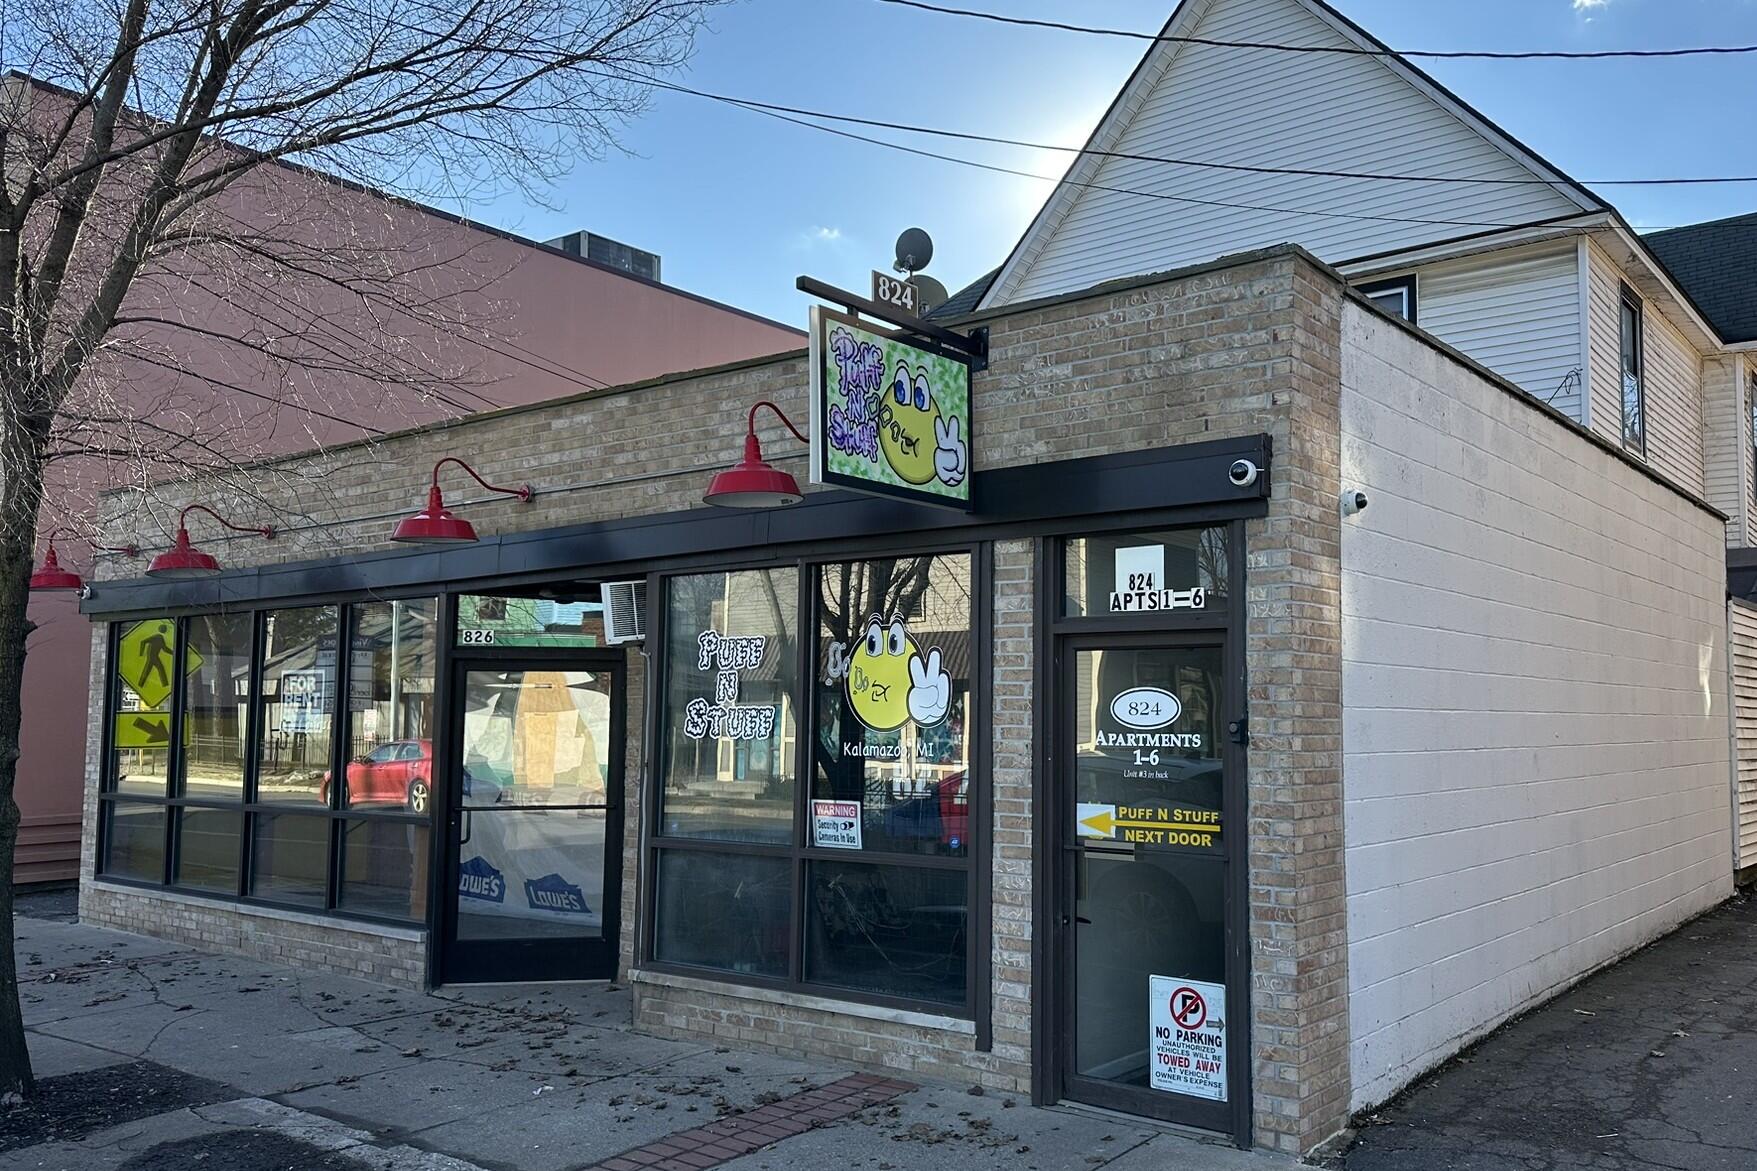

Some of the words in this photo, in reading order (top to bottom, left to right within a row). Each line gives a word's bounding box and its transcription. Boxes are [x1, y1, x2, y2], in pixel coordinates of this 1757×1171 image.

[878, 276, 913, 310] 824
[847, 386, 866, 424] N
[1128, 573, 1153, 591] 824
[463, 630, 493, 644] 826
[698, 630, 766, 670] PUFF
[288, 675, 316, 691] FOR
[716, 670, 739, 703] N
[284, 692, 321, 707] RENT
[1128, 701, 1162, 716] 824
[684, 698, 776, 740] STUFF
[1096, 730, 1201, 747] APARTMENTS
[916, 742, 935, 757] MI
[1133, 750, 1160, 765] 1-6
[1123, 769, 1137, 778] Unit
[1139, 770, 1147, 778] #3
[1148, 770, 1154, 778] in
[1155, 770, 1169, 779] back
[815, 804, 856, 818] WARNING
[1118, 806, 1153, 820] PUFF
[1156, 808, 1169, 821] N
[1174, 808, 1219, 823] STUFF
[817, 819, 839, 833] Security
[817, 831, 840, 843] Cameras
[846, 834, 856, 844] Use
[1124, 830, 1164, 844] NEXT
[1168, 831, 1212, 846] DOOR
[459, 875, 500, 897] OWE'S
[529, 885, 582, 910] LOWE'S
[1156, 1026, 1170, 1039] NO
[1176, 1029, 1222, 1048] PARKING
[1156, 1046, 1190, 1056] VEHICLES
[1192, 1051, 1210, 1060] WILL
[1212, 1054, 1222, 1062] BE
[1162, 1040, 1216, 1054] UNAUTHORIZED
[1157, 1053, 1190, 1068] TOWED
[1196, 1060, 1222, 1074] AWAY
[1155, 1070, 1189, 1082] OWNER'S
[1190, 1078, 1223, 1088] EXPENSE
[1180, 1068, 1210, 1080] VEHICLE
